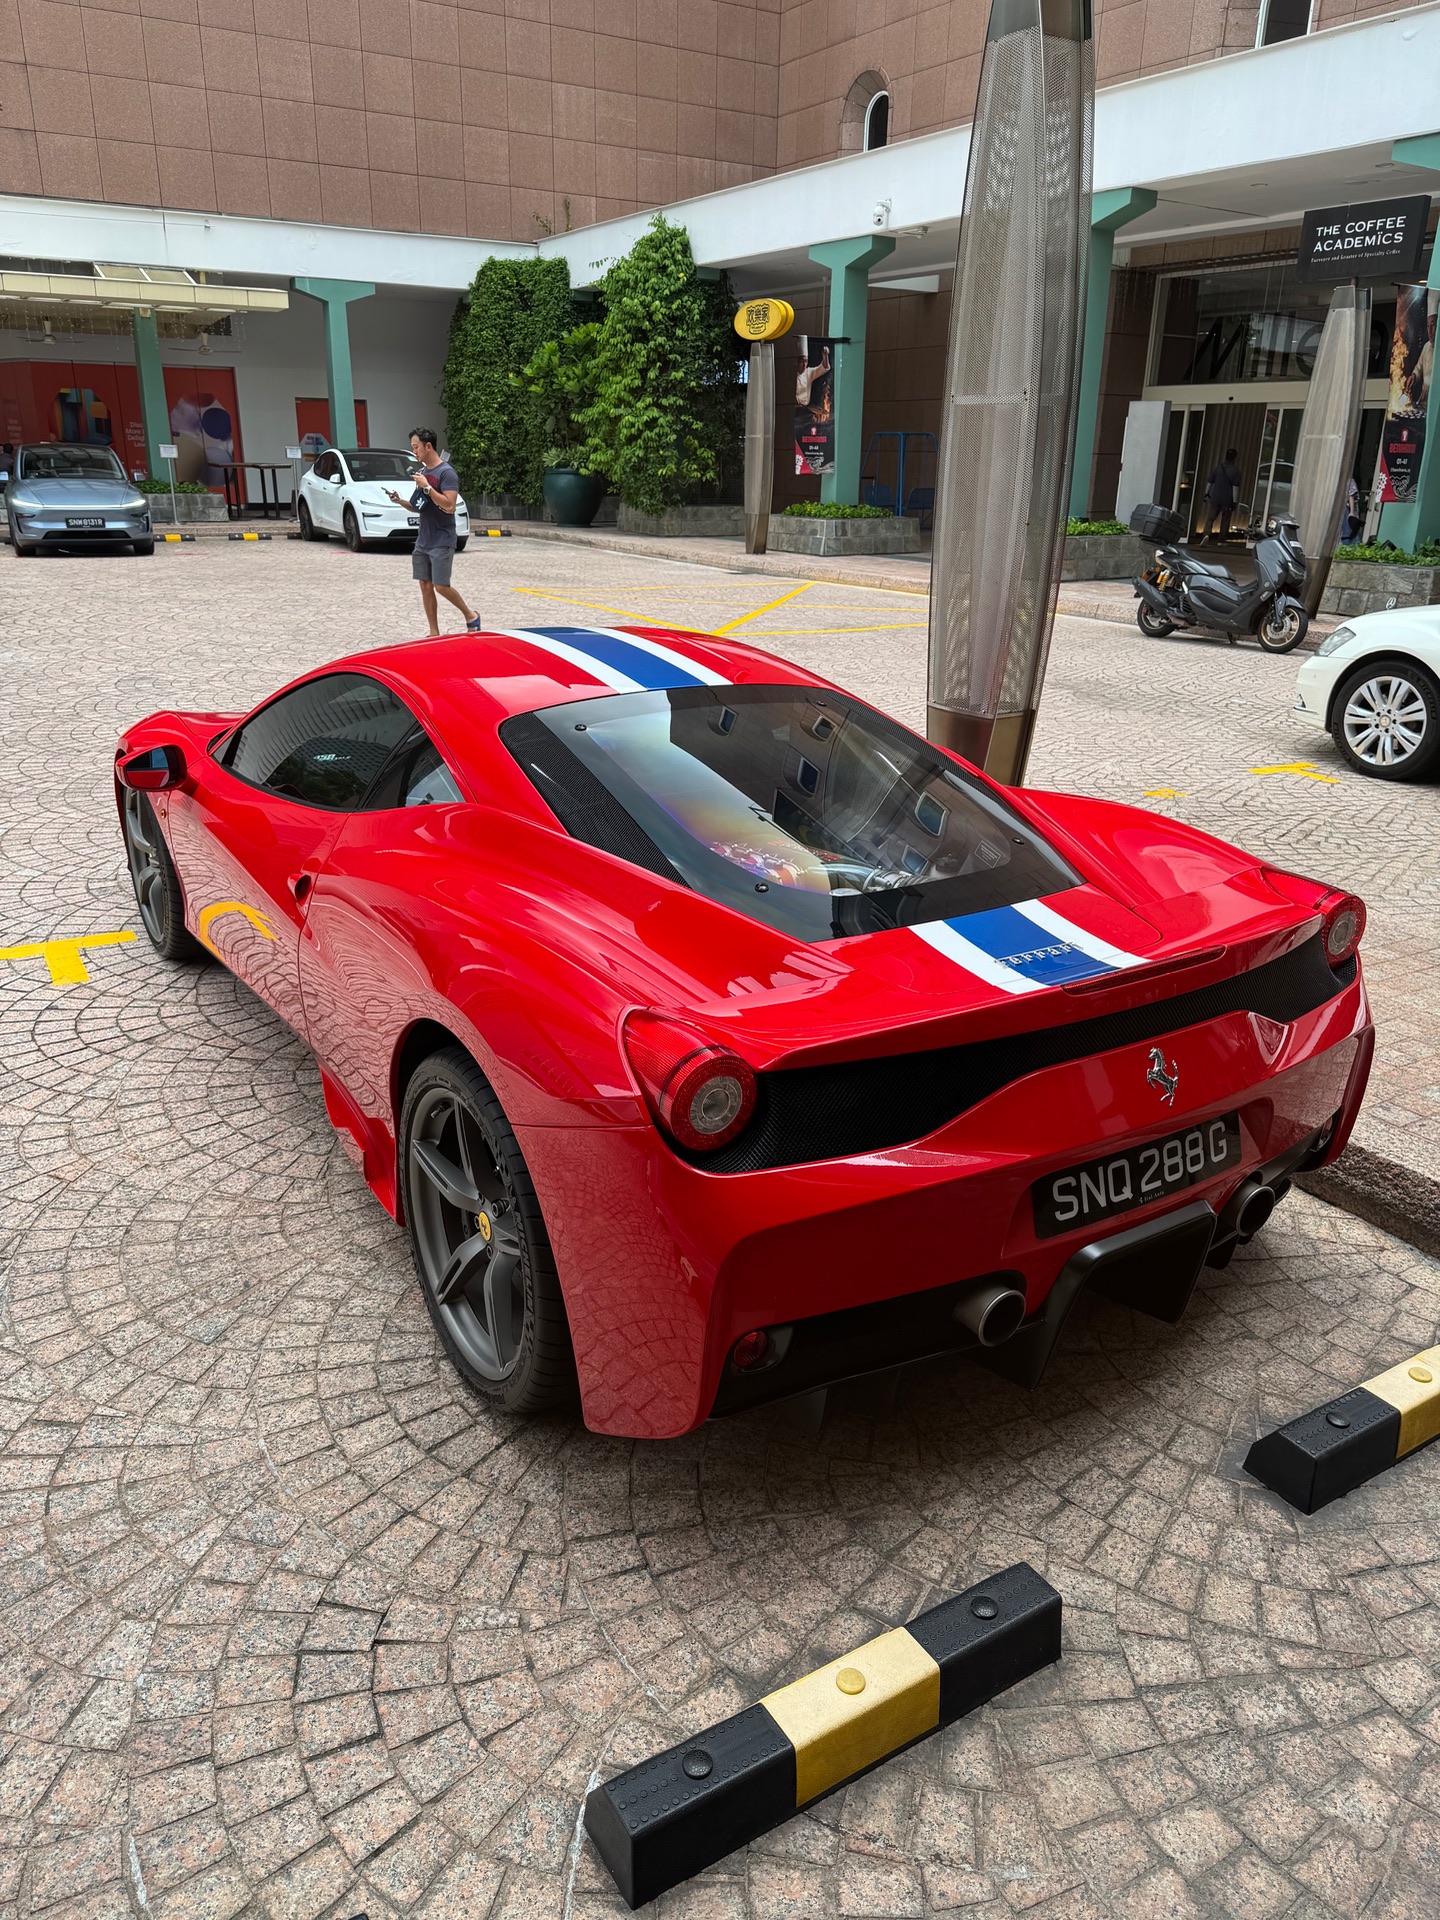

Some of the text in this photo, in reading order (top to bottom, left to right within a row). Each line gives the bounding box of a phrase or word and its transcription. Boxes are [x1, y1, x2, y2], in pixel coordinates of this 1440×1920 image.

[1316, 216, 1407, 237] THE COFFEE
[1364, 249, 1385, 258] Specialty
[993, 941, 1084, 970] Ferrari
[1052, 1158, 1133, 1222] SNQ
[515, 1211, 534, 1314] MICHELIN
